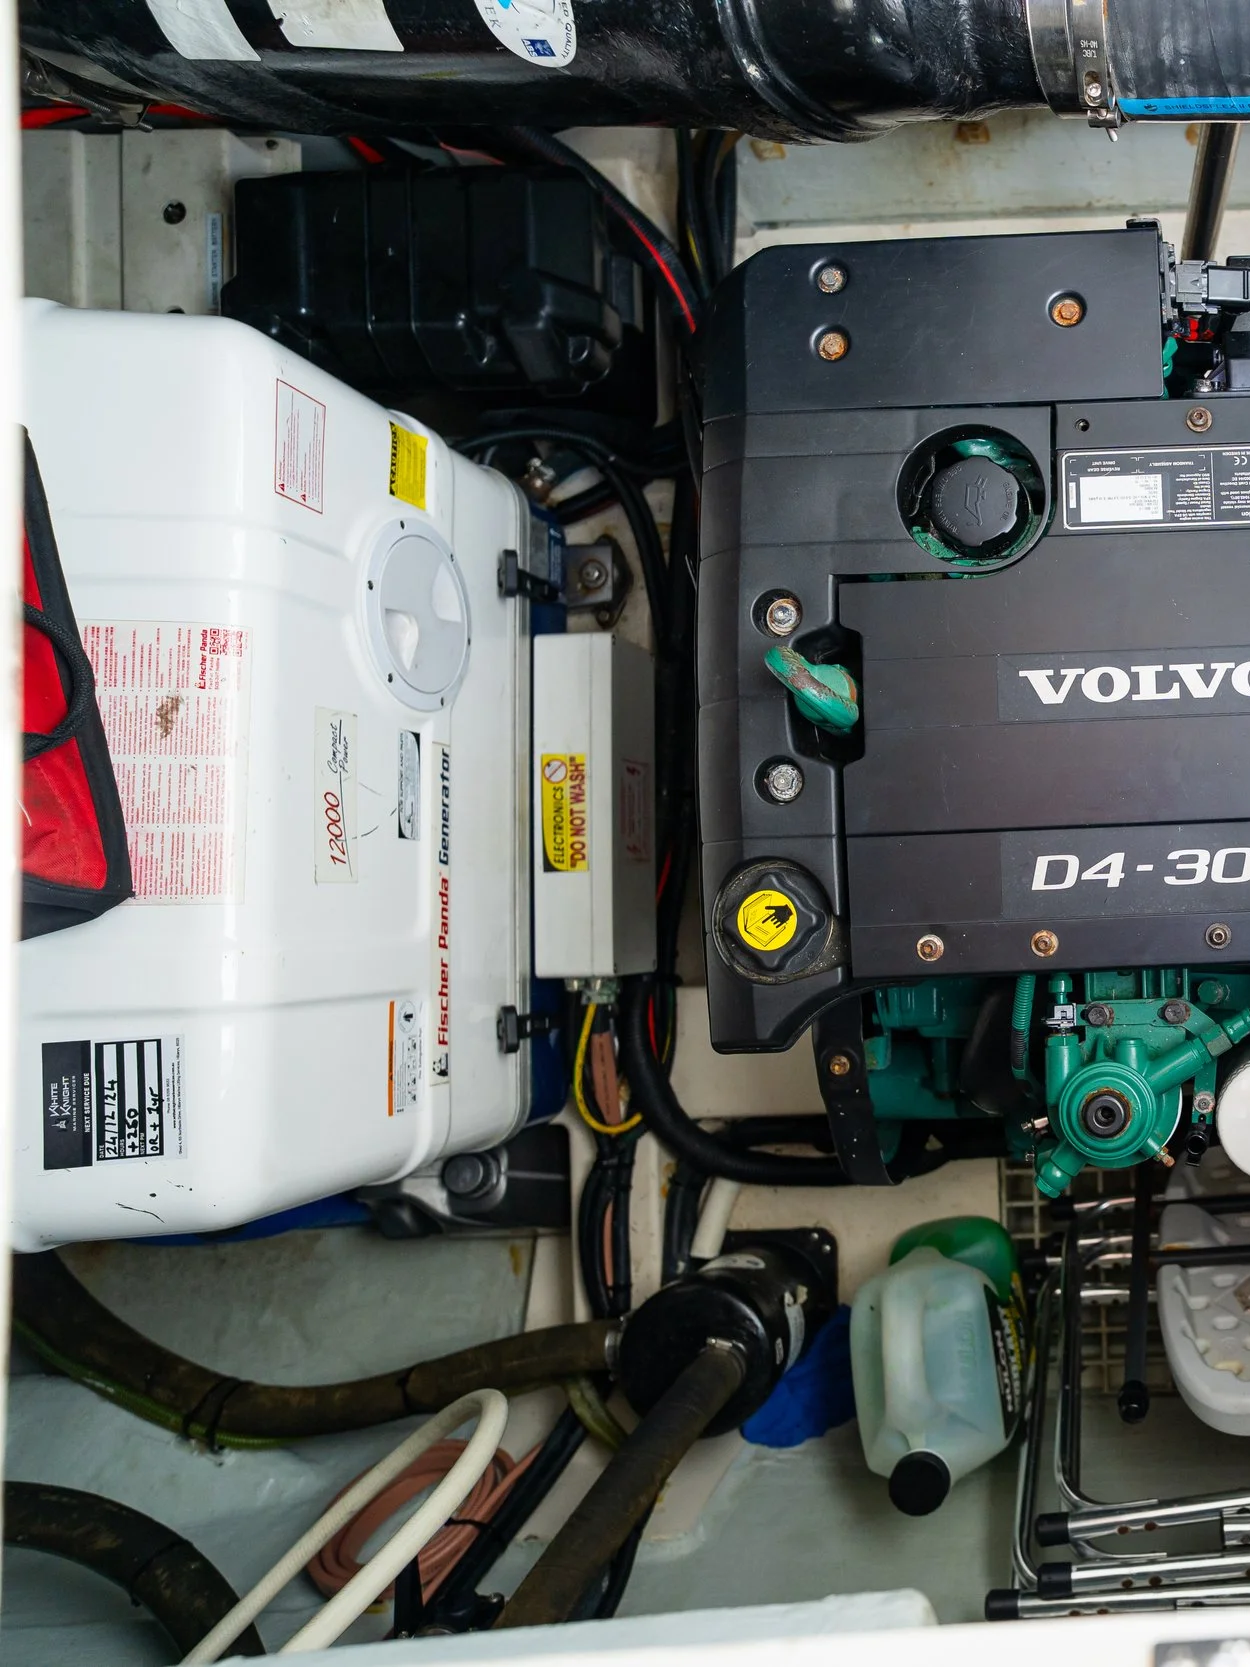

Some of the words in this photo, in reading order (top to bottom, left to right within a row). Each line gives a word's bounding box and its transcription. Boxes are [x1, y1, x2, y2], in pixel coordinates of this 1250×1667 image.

[562, 22, 573, 59] QUALITY
[327, 722, 340, 774] Compact
[339, 736, 349, 773] Power
[323, 792, 347, 865] 12000
[438, 748, 450, 866] Generator
[553, 786, 564, 864] ELECTRONICS
[570, 808, 586, 836] NOT
[437, 877, 449, 950] Panda
[437, 957, 449, 1046] Fischer
[49, 1083, 60, 1117] WHITE
[60, 1076, 71, 1116] KNIGHT
[140, 1133, 145, 1141] PM
